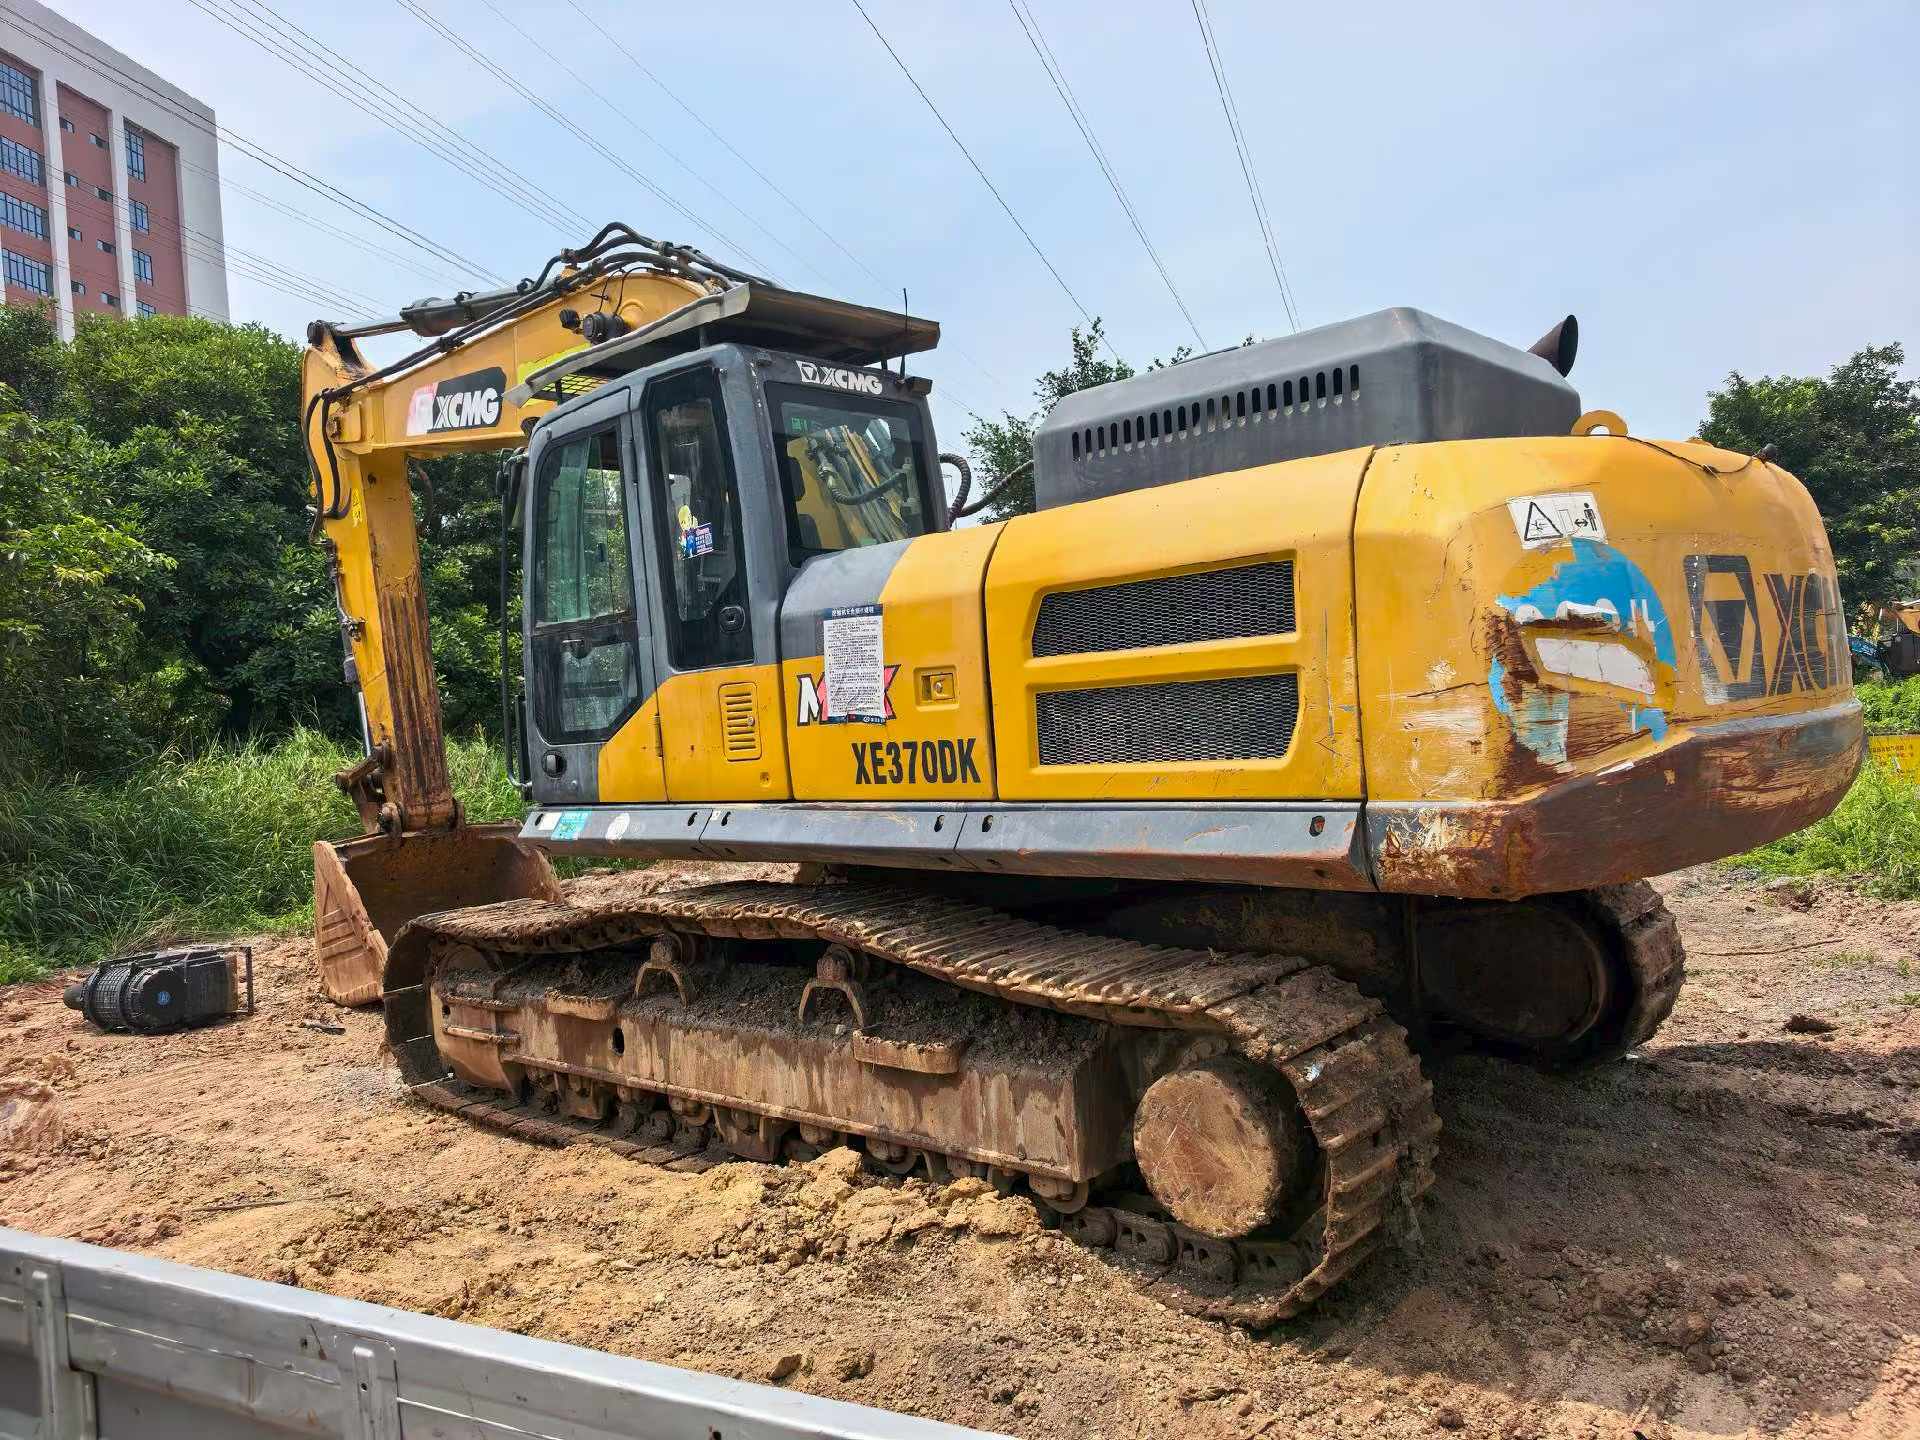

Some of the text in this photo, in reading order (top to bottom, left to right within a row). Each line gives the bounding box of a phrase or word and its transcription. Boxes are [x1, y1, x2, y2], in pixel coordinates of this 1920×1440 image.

[820, 366, 883, 395] XCMG
[433, 387, 499, 430] XCMG
[851, 738, 982, 785] XE370DK
